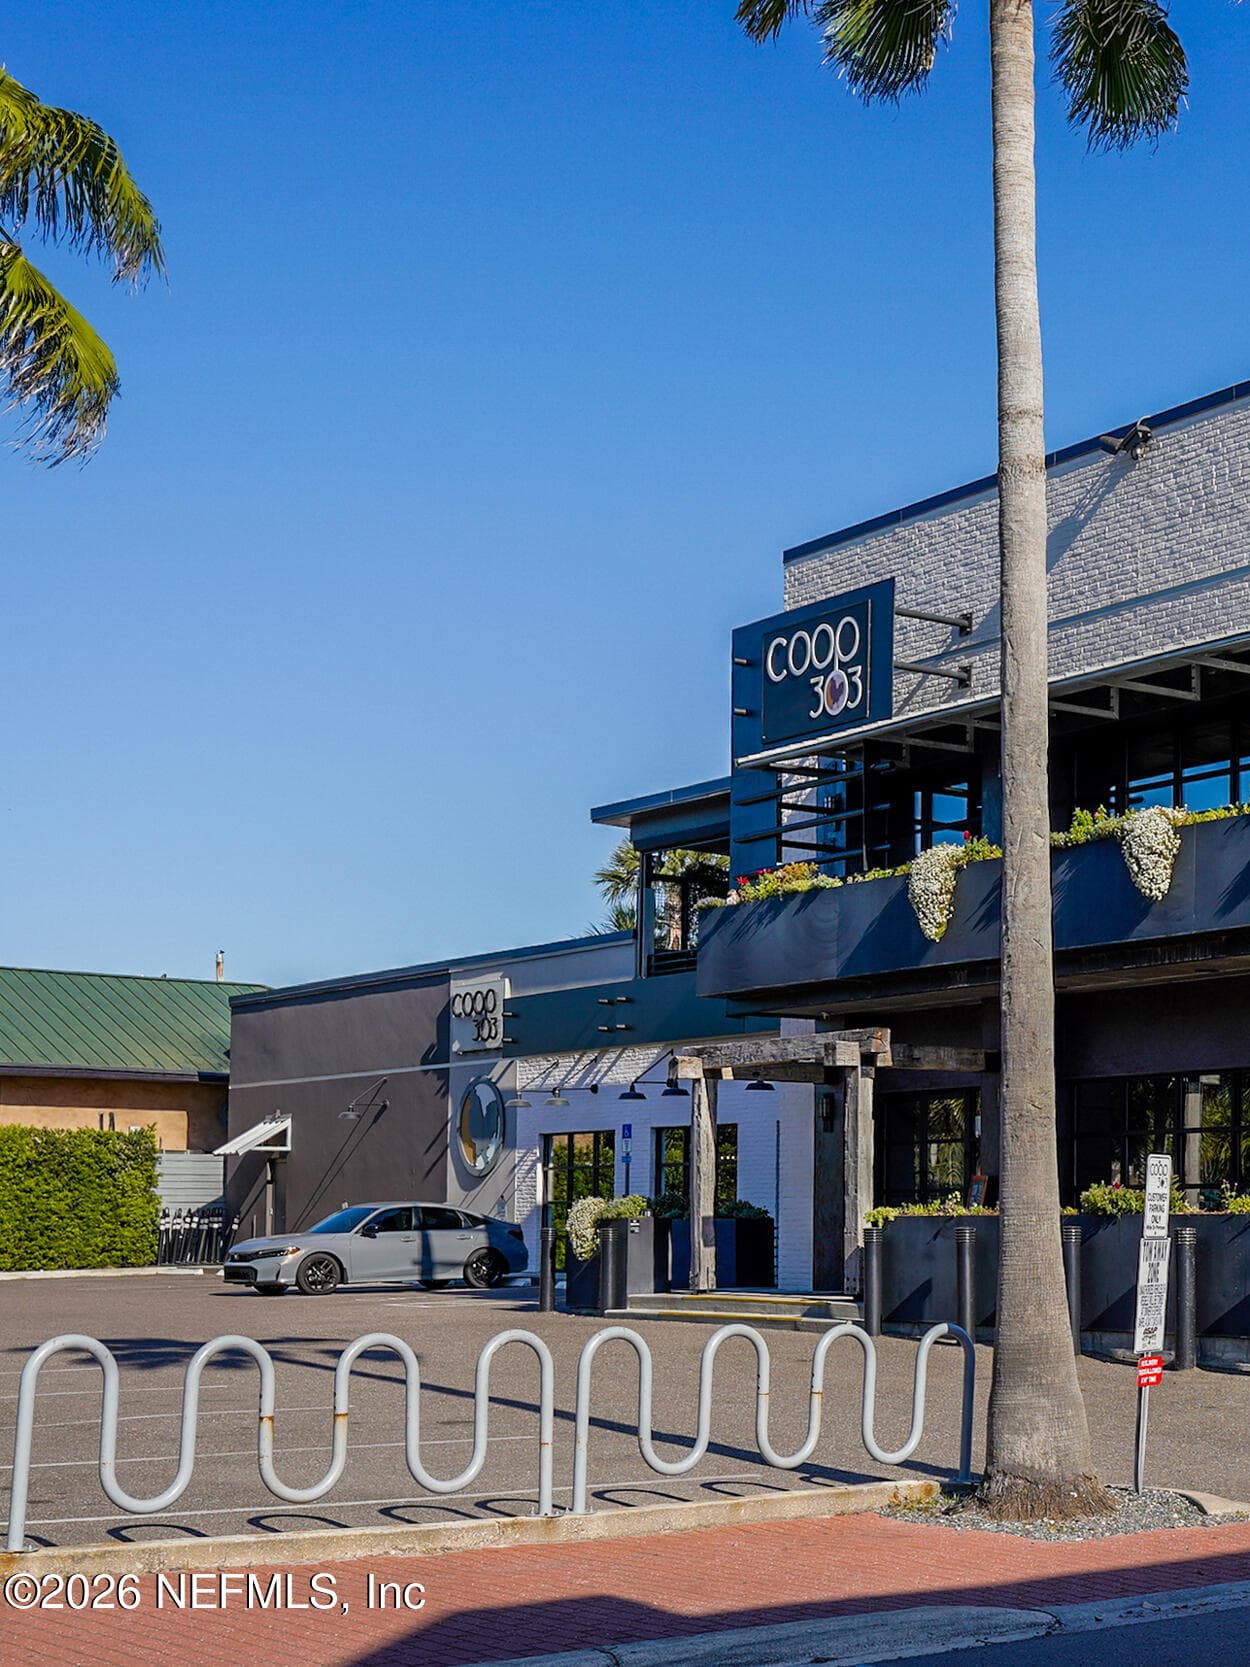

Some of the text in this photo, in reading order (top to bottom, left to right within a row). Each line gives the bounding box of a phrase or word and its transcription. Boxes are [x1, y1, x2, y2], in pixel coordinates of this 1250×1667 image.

[809, 665, 862, 719] 303
[472, 1017, 498, 1041] 303
[1148, 1203, 1165, 1213] PARKING
[1150, 1214, 1161, 1224] ONLY
